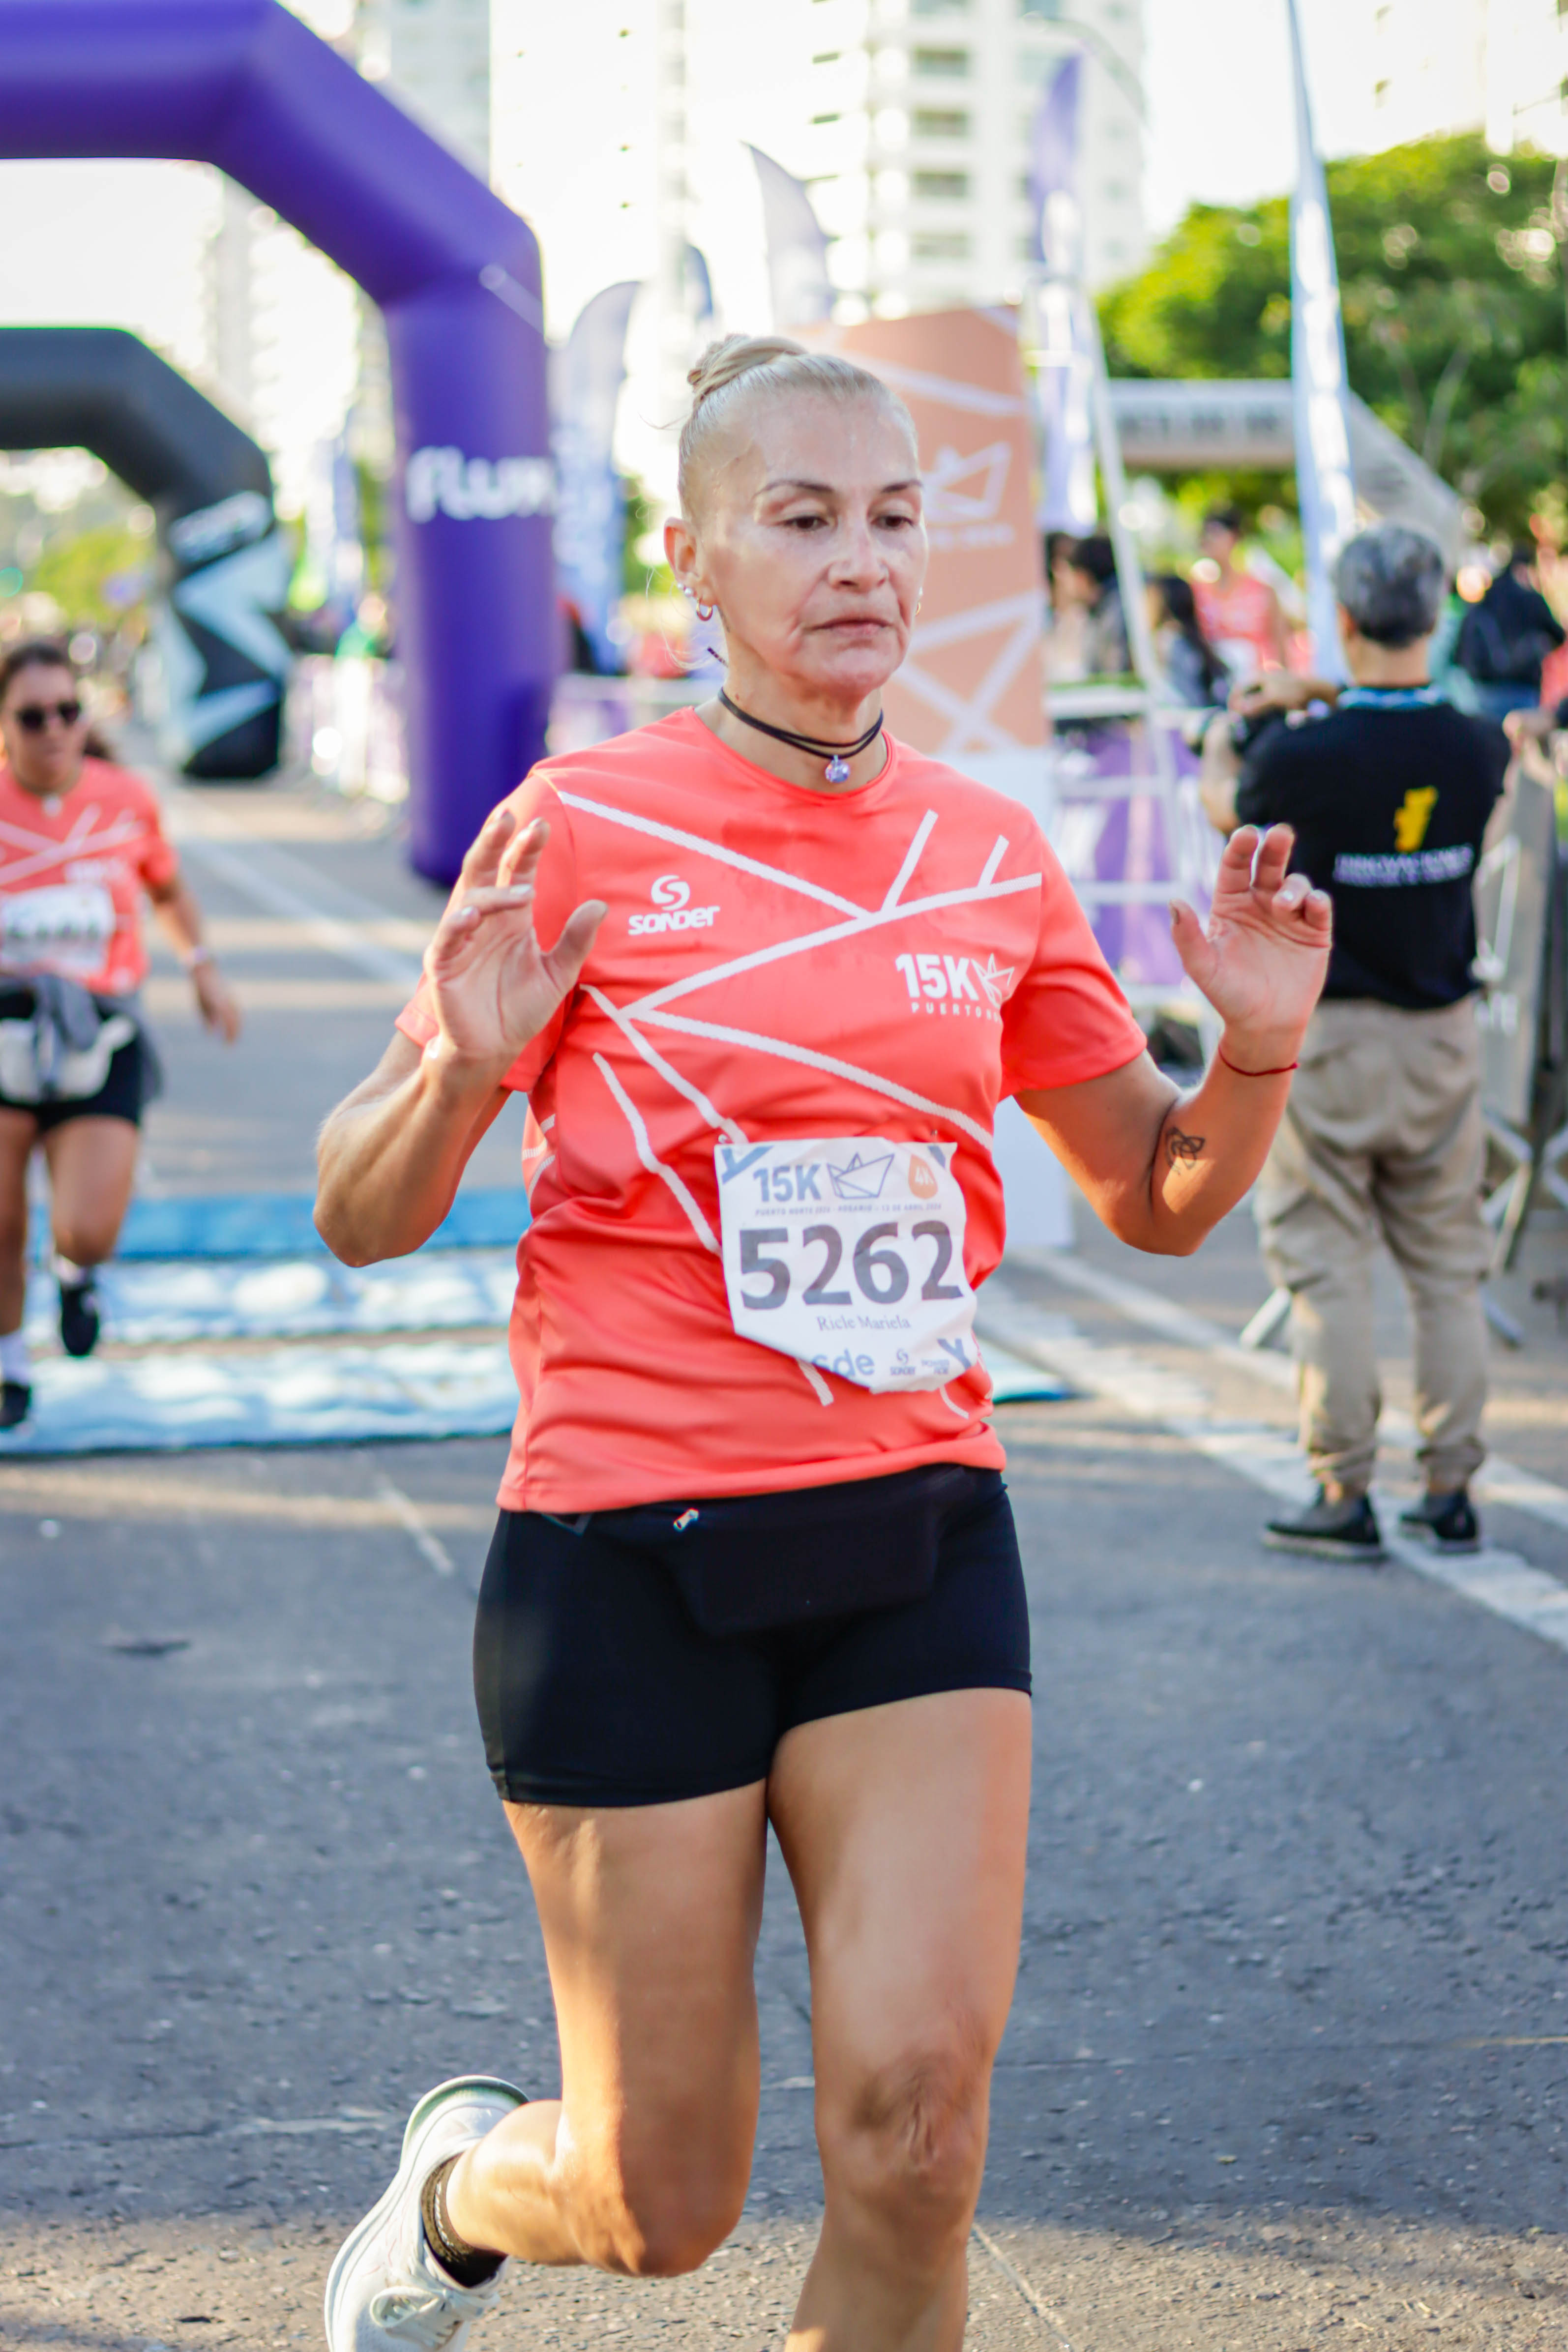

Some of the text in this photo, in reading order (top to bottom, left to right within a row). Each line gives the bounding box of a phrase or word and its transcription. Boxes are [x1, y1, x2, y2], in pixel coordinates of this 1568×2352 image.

[895, 953, 979, 1000] 15K
[911, 1001, 982, 1018] PUERTO
[753, 1163, 822, 1202] 15K
[915, 1166, 934, 1185] 4K
[740, 1220, 964, 1310] 5262
[858, 1315, 912, 1329] Mariela
